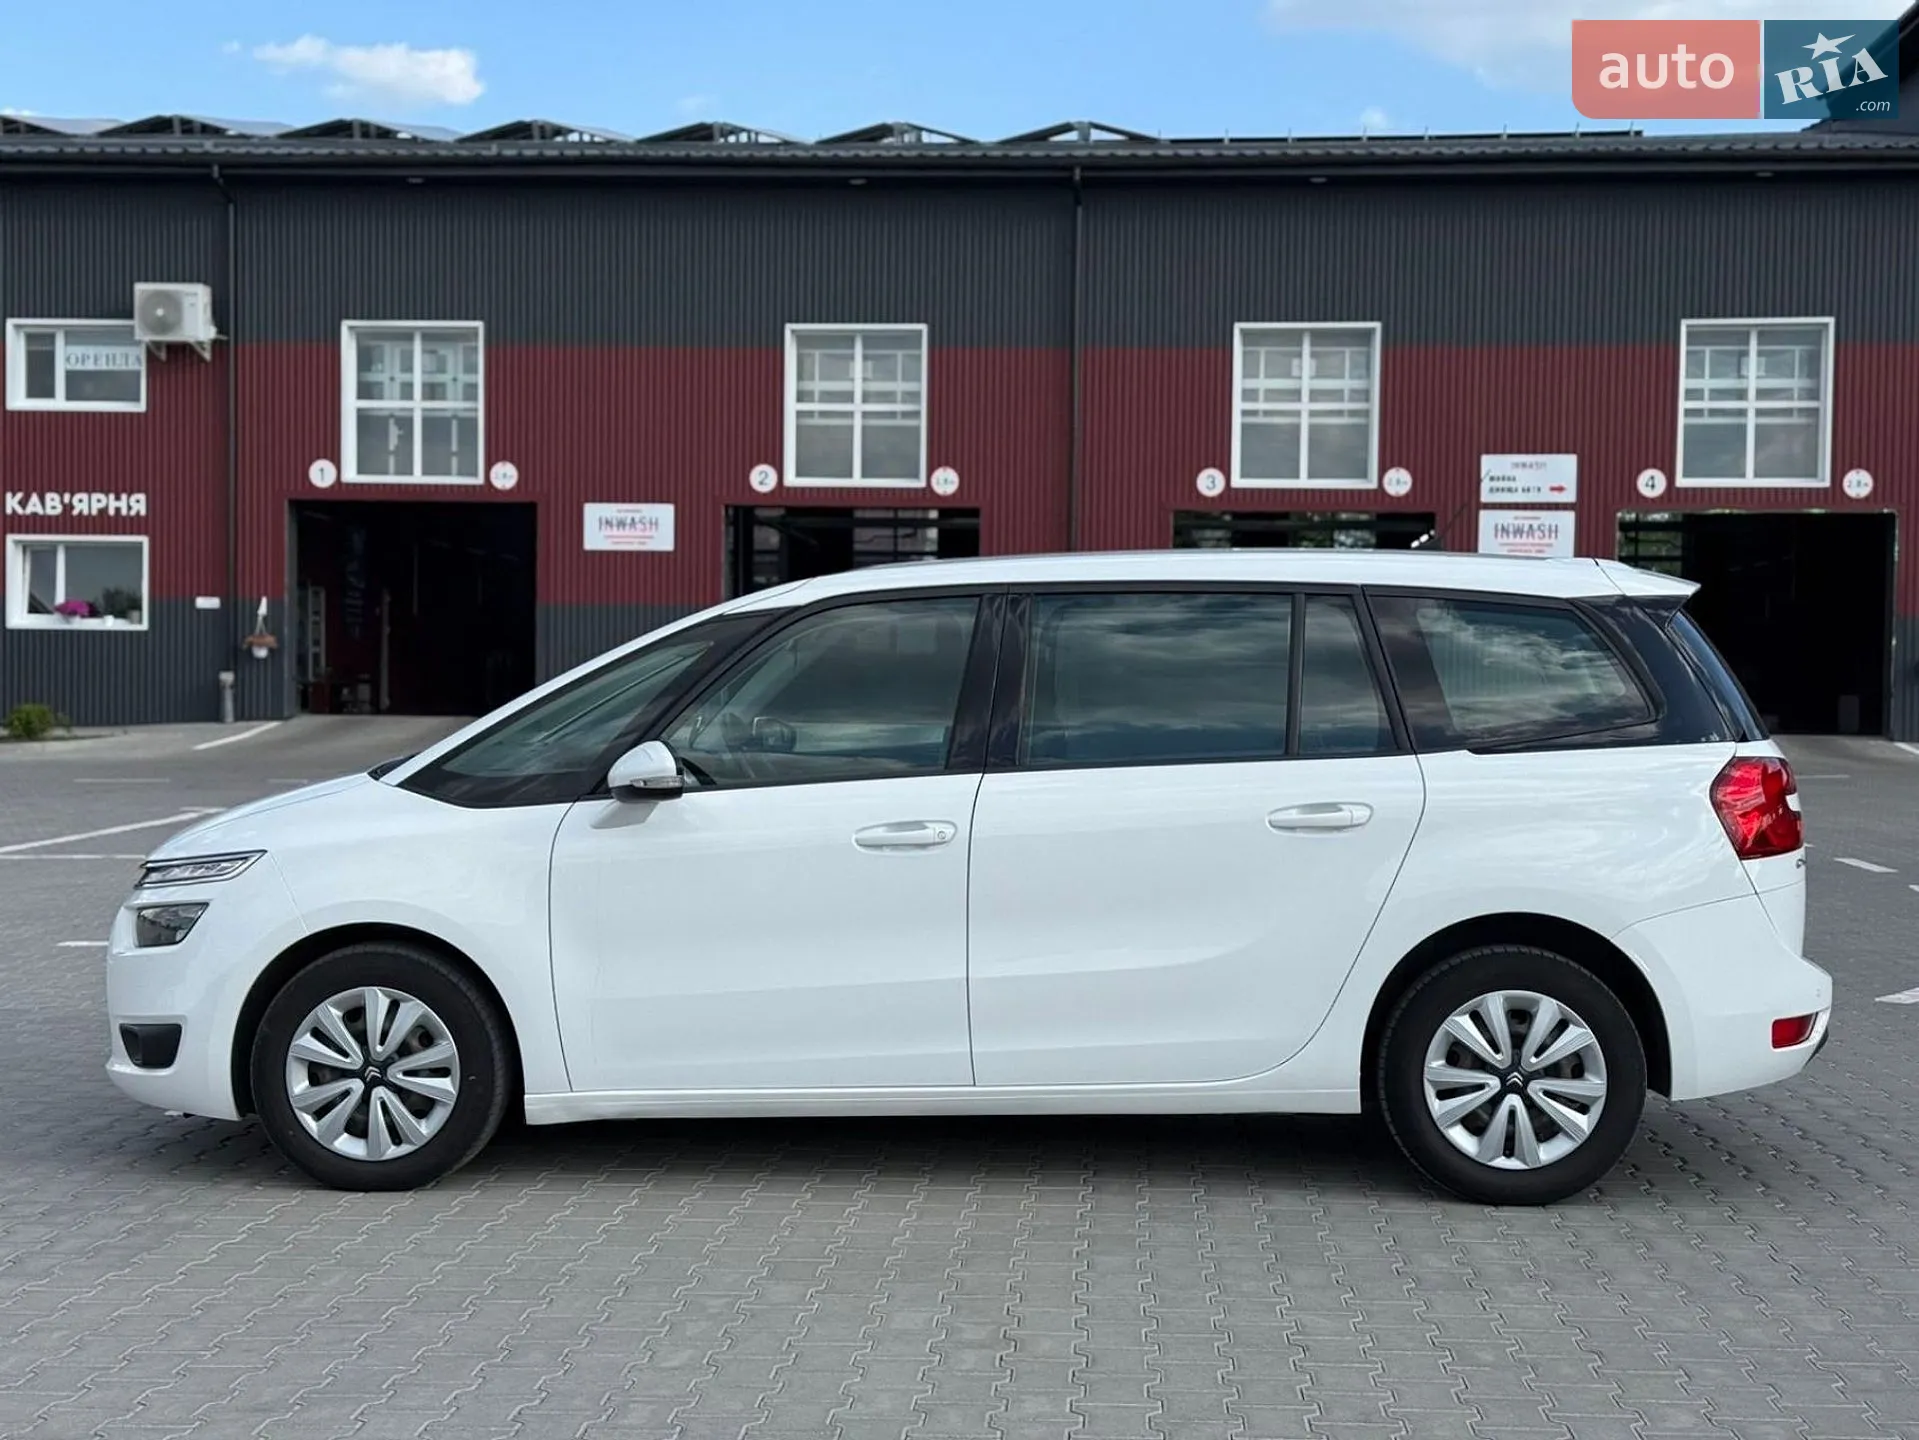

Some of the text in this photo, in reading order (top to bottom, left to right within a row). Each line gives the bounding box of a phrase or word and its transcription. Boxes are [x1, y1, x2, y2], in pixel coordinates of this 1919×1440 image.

[317, 466, 325, 482] 1
[758, 470, 769, 486] 2
[1205, 474, 1216, 490] 3
[1645, 474, 1656, 491] 4
[5, 491, 147, 517] КАВ'ЯРНЯ
[598, 516, 659, 532] INWASH
[1494, 523, 1559, 540] INWASH
